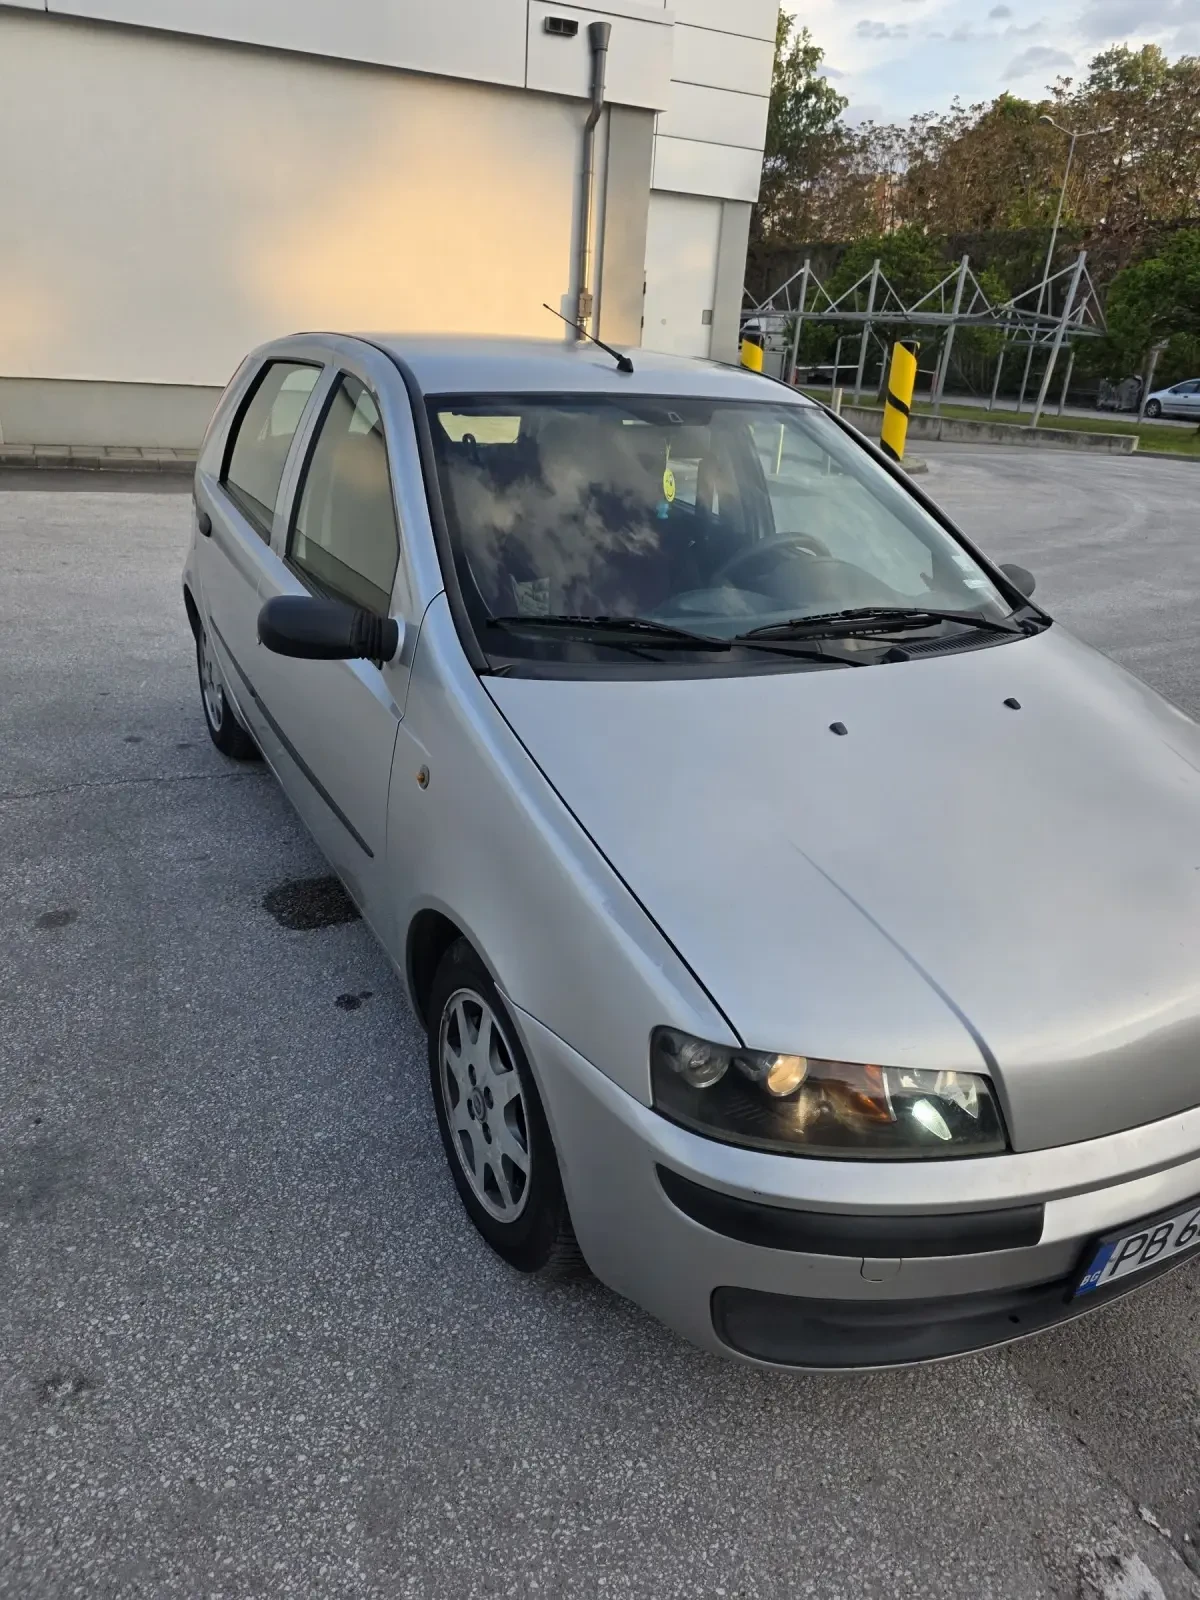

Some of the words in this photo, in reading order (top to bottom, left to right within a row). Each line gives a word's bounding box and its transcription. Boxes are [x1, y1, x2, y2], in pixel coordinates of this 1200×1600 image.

[1109, 1222, 1174, 1277] PB
[1175, 1209, 1200, 1248] 6
[1080, 1270, 1101, 1287] BG
